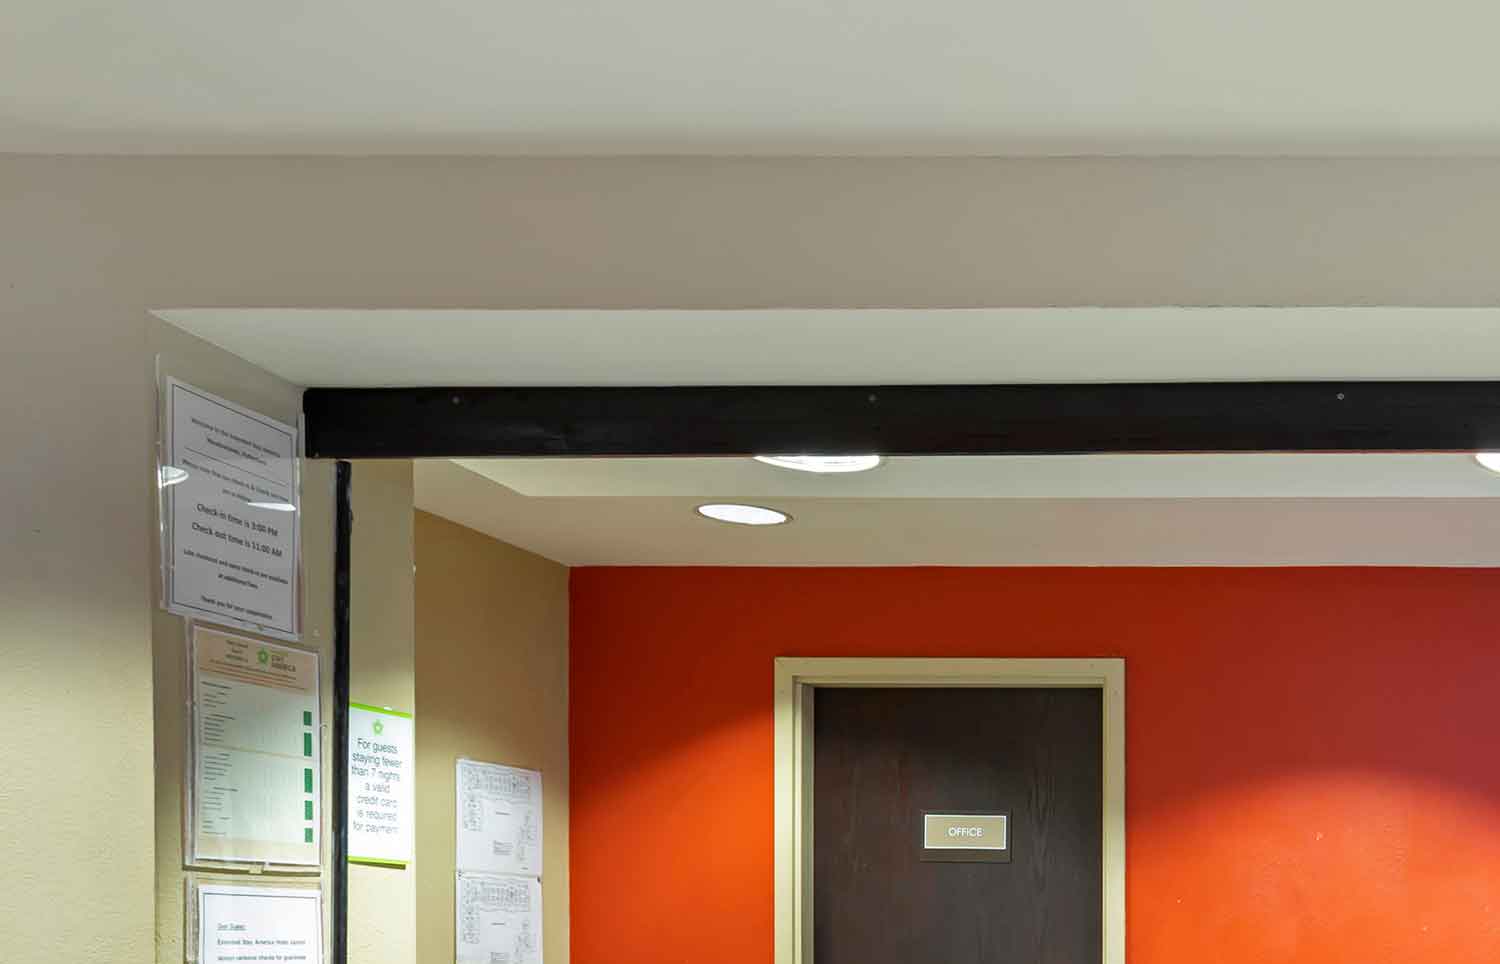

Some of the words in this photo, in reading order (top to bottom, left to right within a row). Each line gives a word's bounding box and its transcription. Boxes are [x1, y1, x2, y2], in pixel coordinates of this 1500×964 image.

[357, 737, 371, 749] For
[372, 742, 398, 754] guests
[352, 753, 380, 767] staying
[382, 756, 402, 767] fewer
[351, 766, 369, 776] than
[378, 770, 400, 783] nights
[372, 784, 390, 793] valid
[357, 795, 378, 804] credit
[366, 810, 397, 821] required
[353, 820, 363, 831] for
[366, 823, 399, 835] payment
[948, 827, 983, 837] OFFICE
